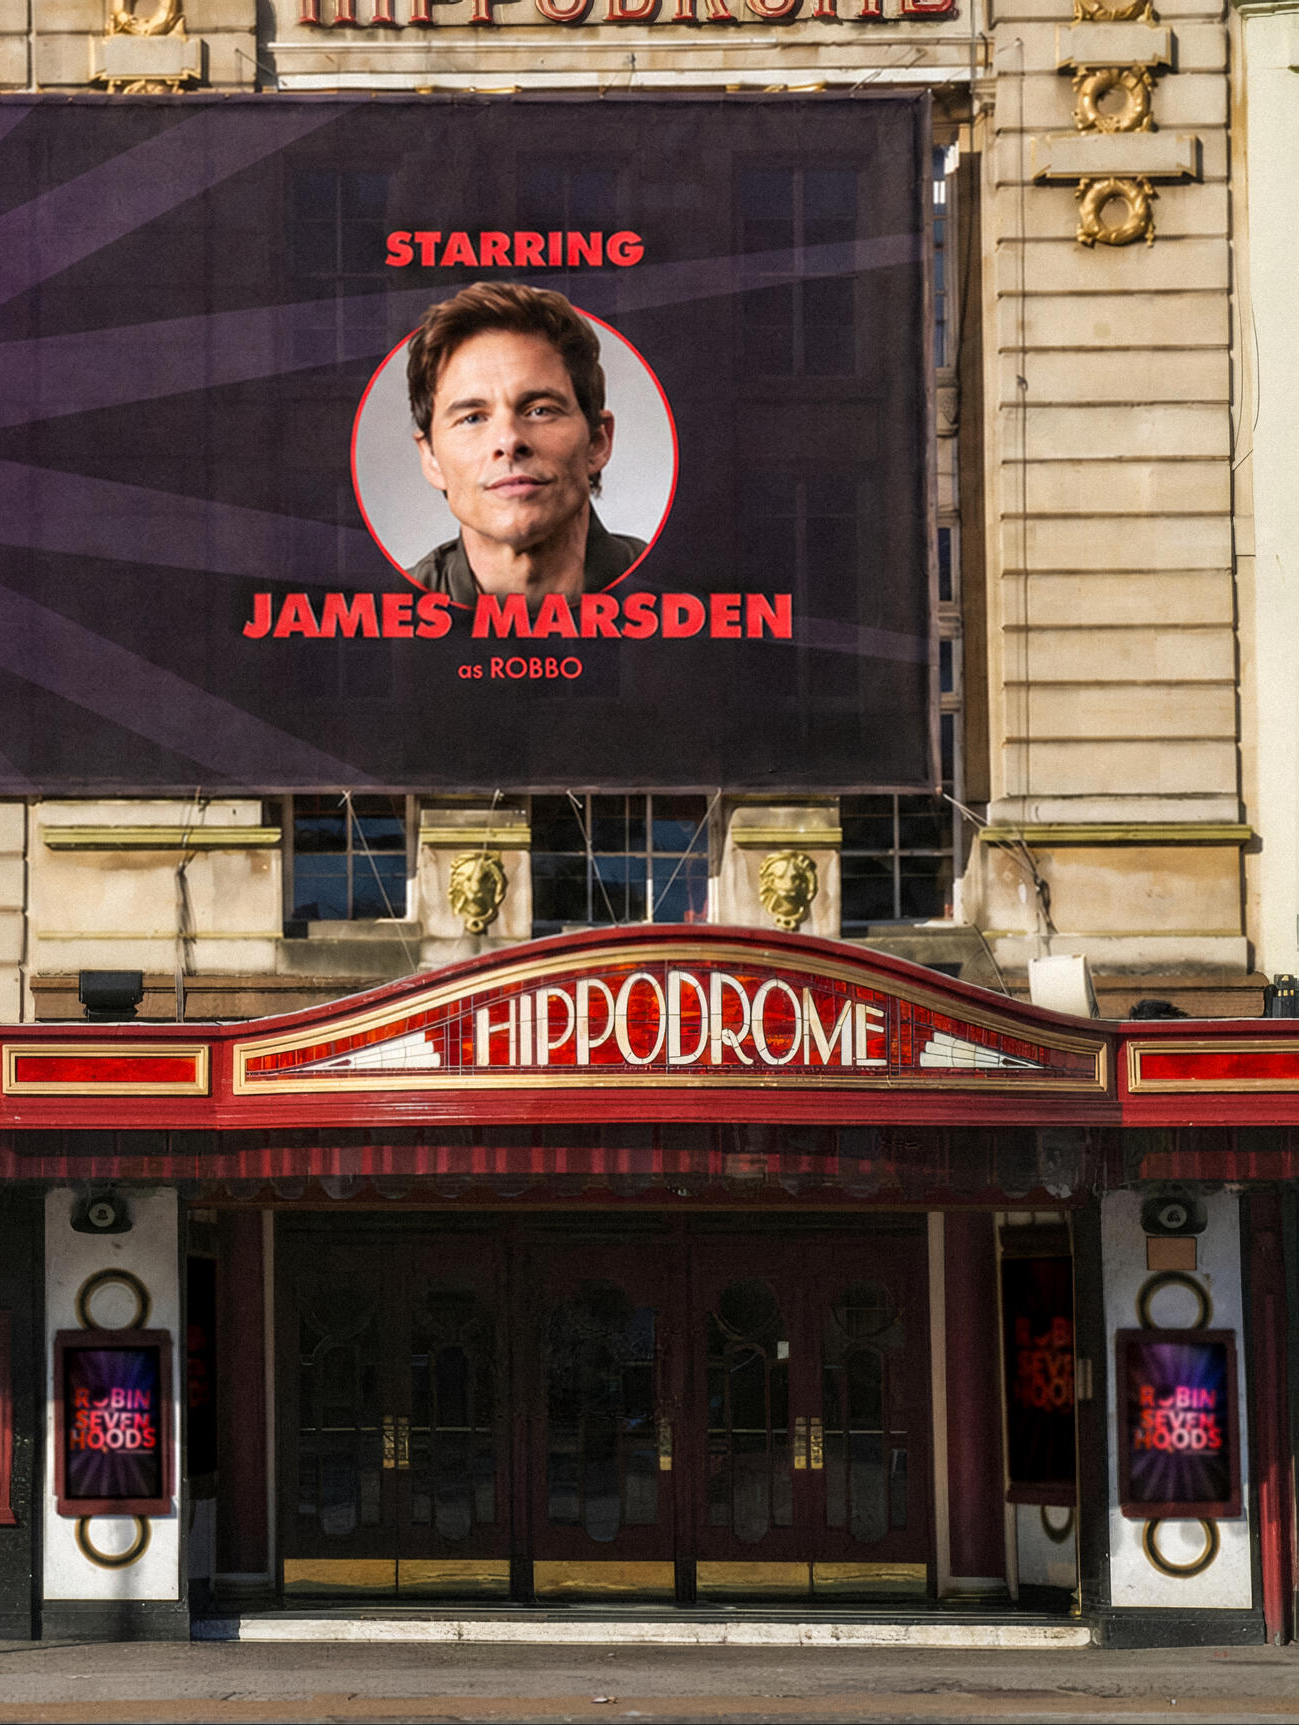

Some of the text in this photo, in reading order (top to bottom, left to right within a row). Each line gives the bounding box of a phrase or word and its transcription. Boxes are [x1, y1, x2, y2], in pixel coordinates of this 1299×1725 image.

[385, 231, 645, 267] STARRING
[242, 593, 794, 639] JAMES MARSDEN
[457, 657, 583, 680] as ROBBO
[475, 970, 888, 1066] HIPPODROME
